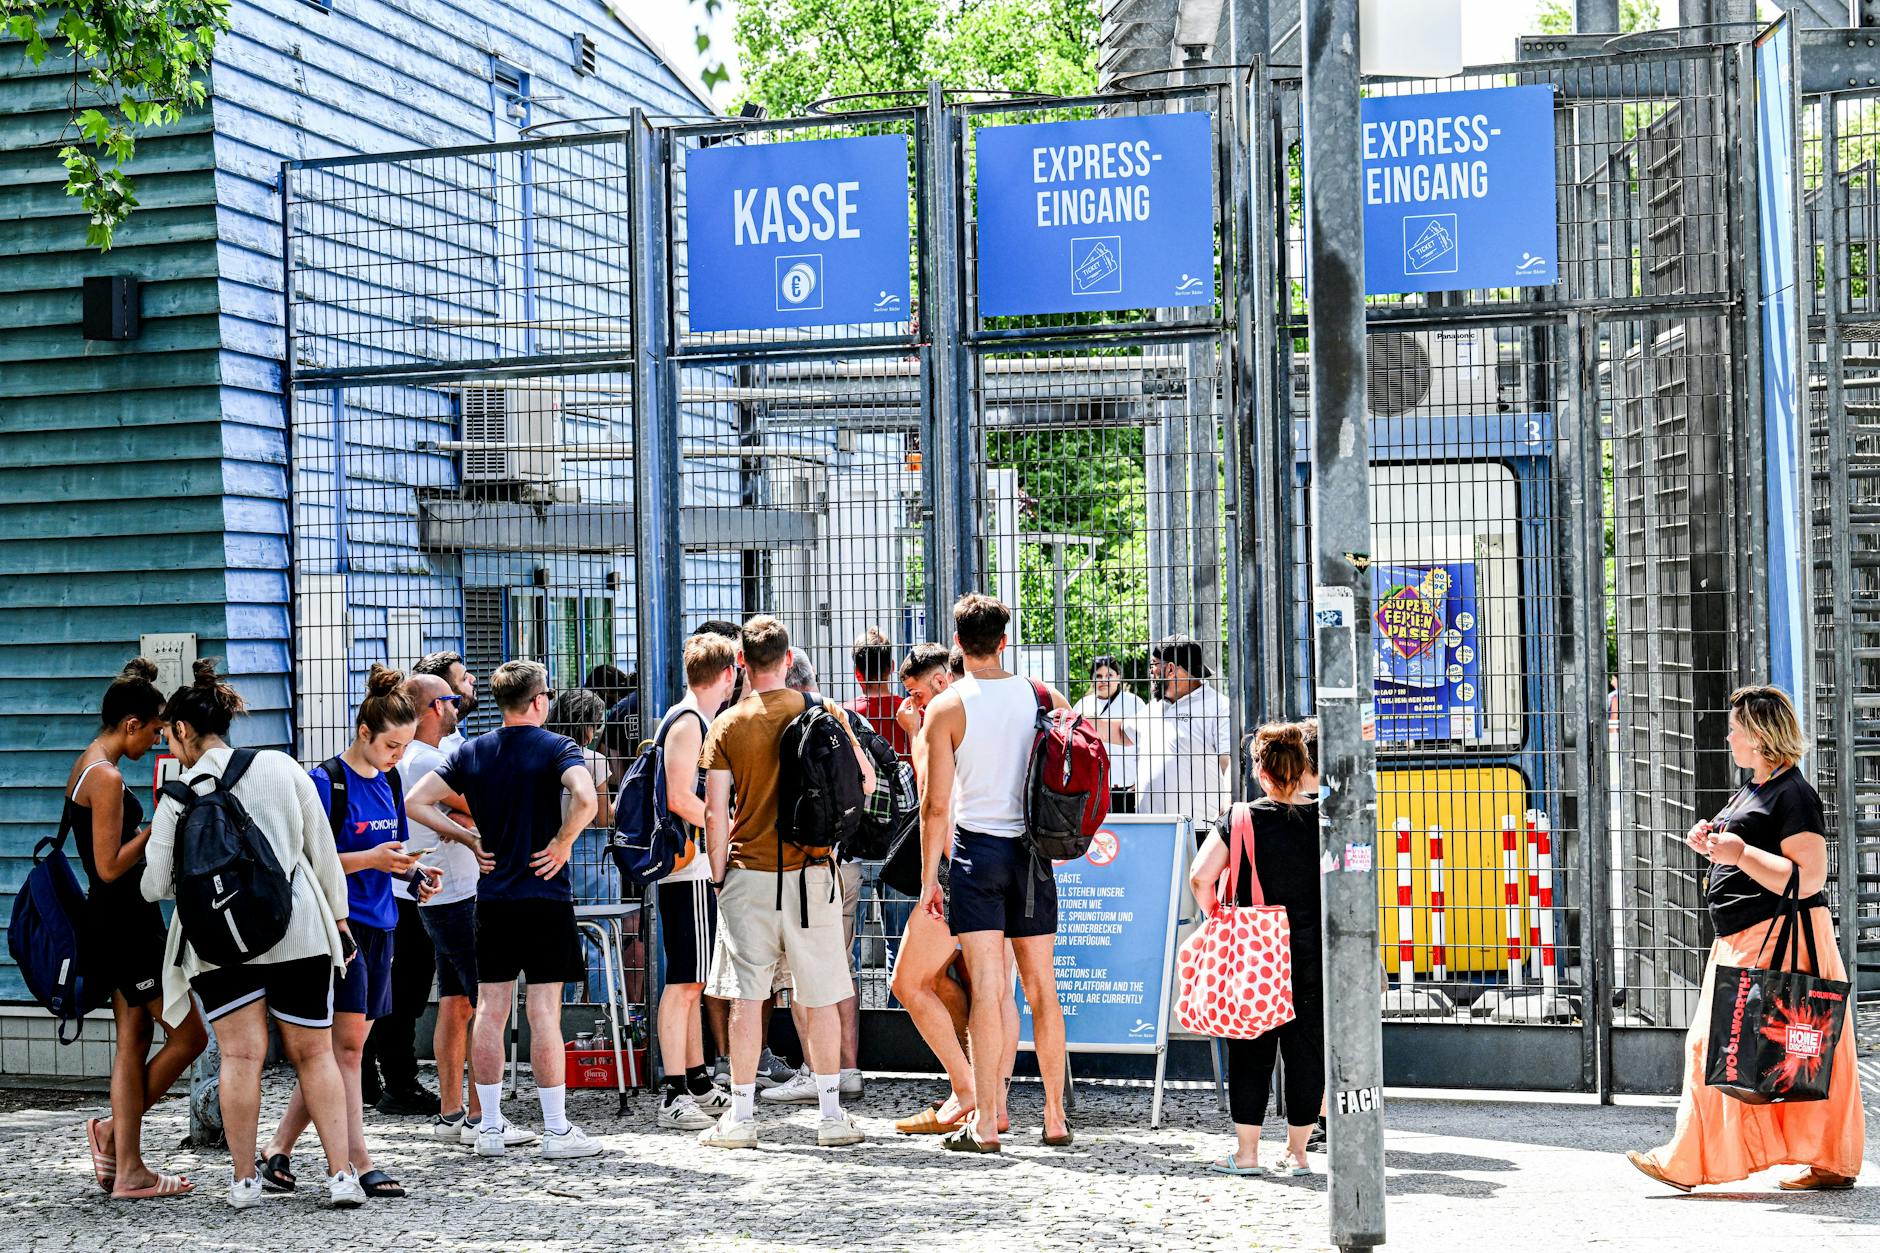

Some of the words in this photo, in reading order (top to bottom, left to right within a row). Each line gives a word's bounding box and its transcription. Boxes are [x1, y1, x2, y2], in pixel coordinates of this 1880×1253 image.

[1362, 114, 1501, 160] EXPRESS-
[1033, 140, 1162, 184] EXPRESS-
[1366, 160, 1488, 205] EINGANG
[1037, 184, 1150, 227] EINGANG
[734, 181, 861, 246] KASSE
[1415, 239, 1436, 256] TICKET
[1082, 261, 1101, 276] TICKET
[1436, 332, 1475, 340] Panasonic
[1523, 421, 1541, 446] 3
[1387, 597, 1431, 614] SUPER
[1387, 624, 1430, 642] PASS
[1058, 872, 1083, 885] GÄSTE,
[1068, 887, 1096, 897] STEHEN
[1097, 887, 1125, 898] UNSERE
[1058, 899, 1088, 909] KTIONEN
[1089, 899, 1103, 909] WIE
[1068, 911, 1117, 922] SPRUNGTURM
[1117, 911, 1133, 922] UND
[1067, 923, 1123, 934] KINDERBECKEN
[1069, 934, 1112, 946] VERFÜGUNG.
[1091, 968, 1107, 979] LIKE
[1074, 981, 1111, 991] PLATFORM
[1113, 981, 1129, 991] AND
[1130, 982, 1144, 992] THE
[1067, 993, 1085, 1003] POOL
[1086, 993, 1101, 1003] ARE
[1102, 994, 1144, 1004] CURRENTLY
[1726, 976, 1751, 1082] WOOLWORTH
[1789, 1030, 1819, 1046] HOME
[1788, 1043, 1817, 1054] DISCOUNT
[1336, 1086, 1381, 1115] FACH
